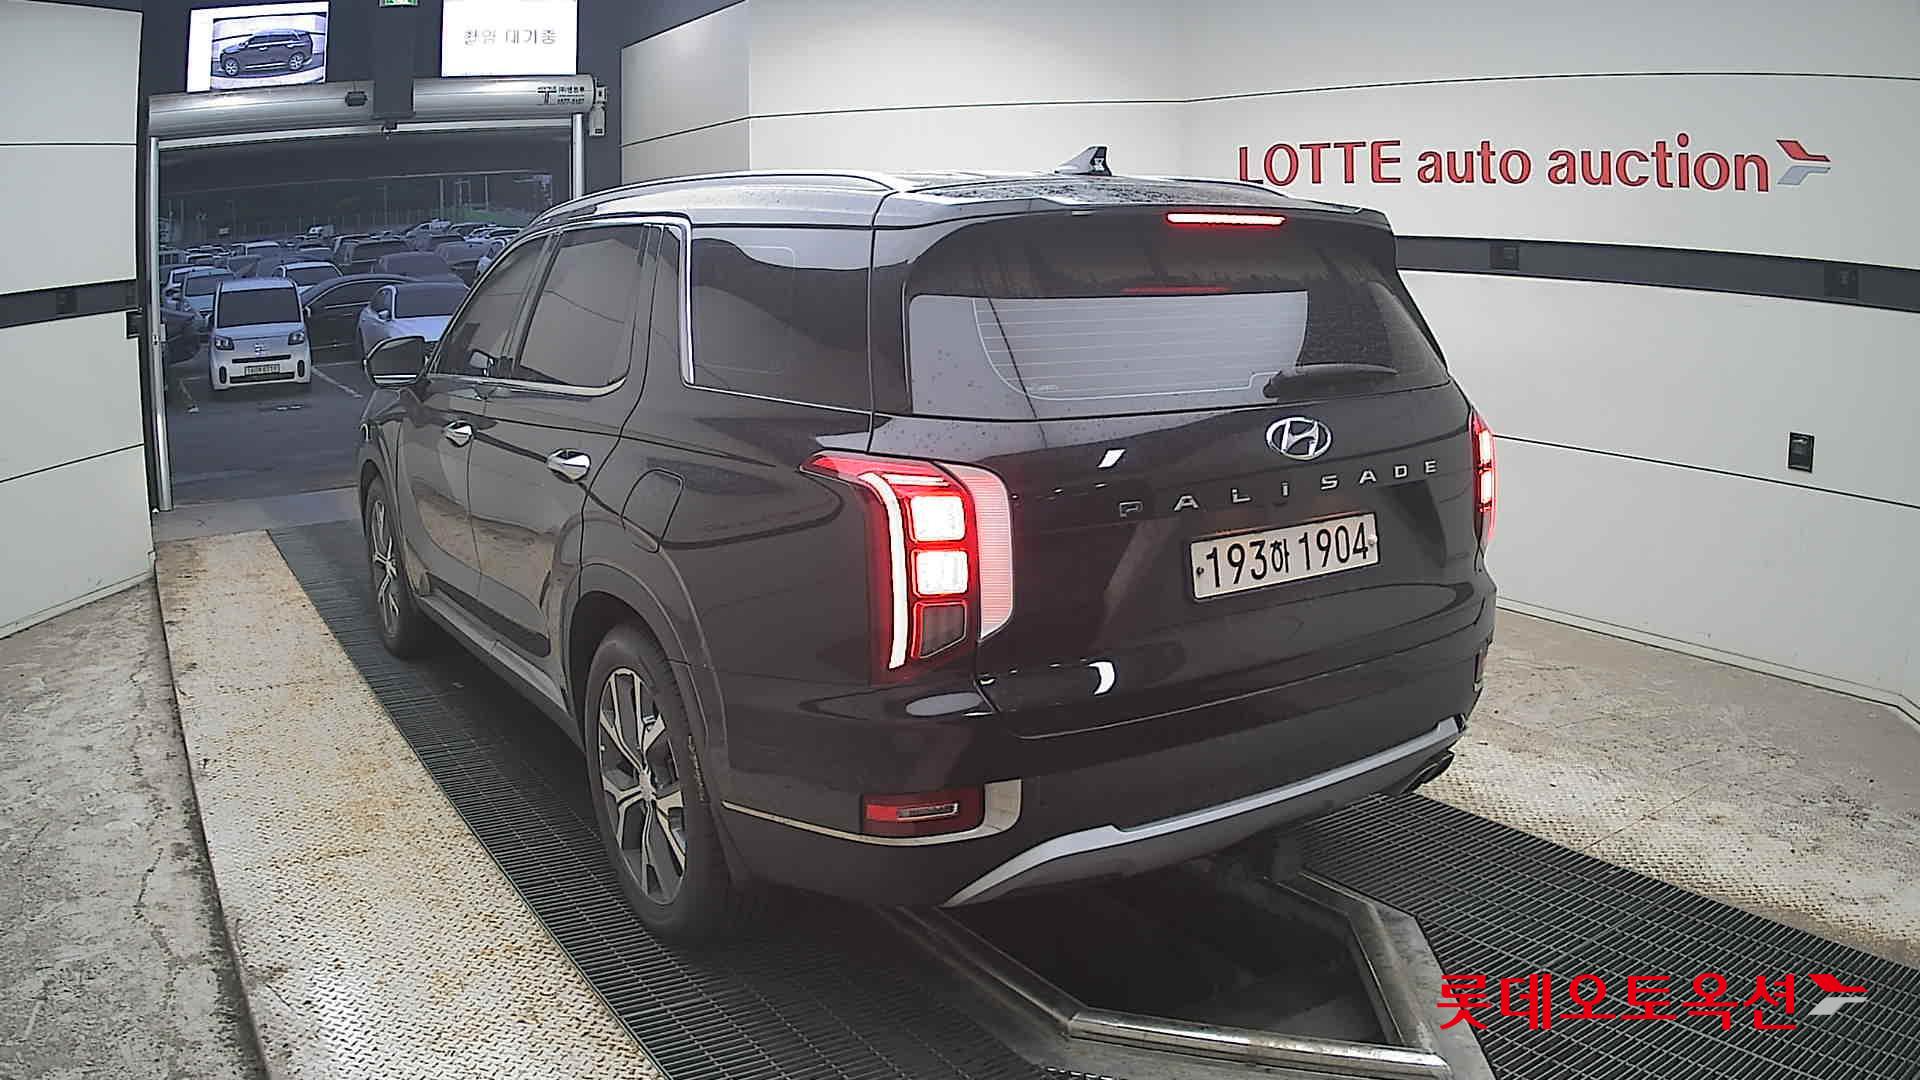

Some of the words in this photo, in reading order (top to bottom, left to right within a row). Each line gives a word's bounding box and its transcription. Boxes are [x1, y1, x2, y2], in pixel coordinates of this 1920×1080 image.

[504, 28, 557, 45] 대기중
[1238, 139, 1401, 186] LOTTE
[1417, 140, 1532, 184] auto
[1548, 132, 1769, 192] auction
[1119, 459, 1437, 518] PALISADE
[1299, 522, 1369, 571] 1904
